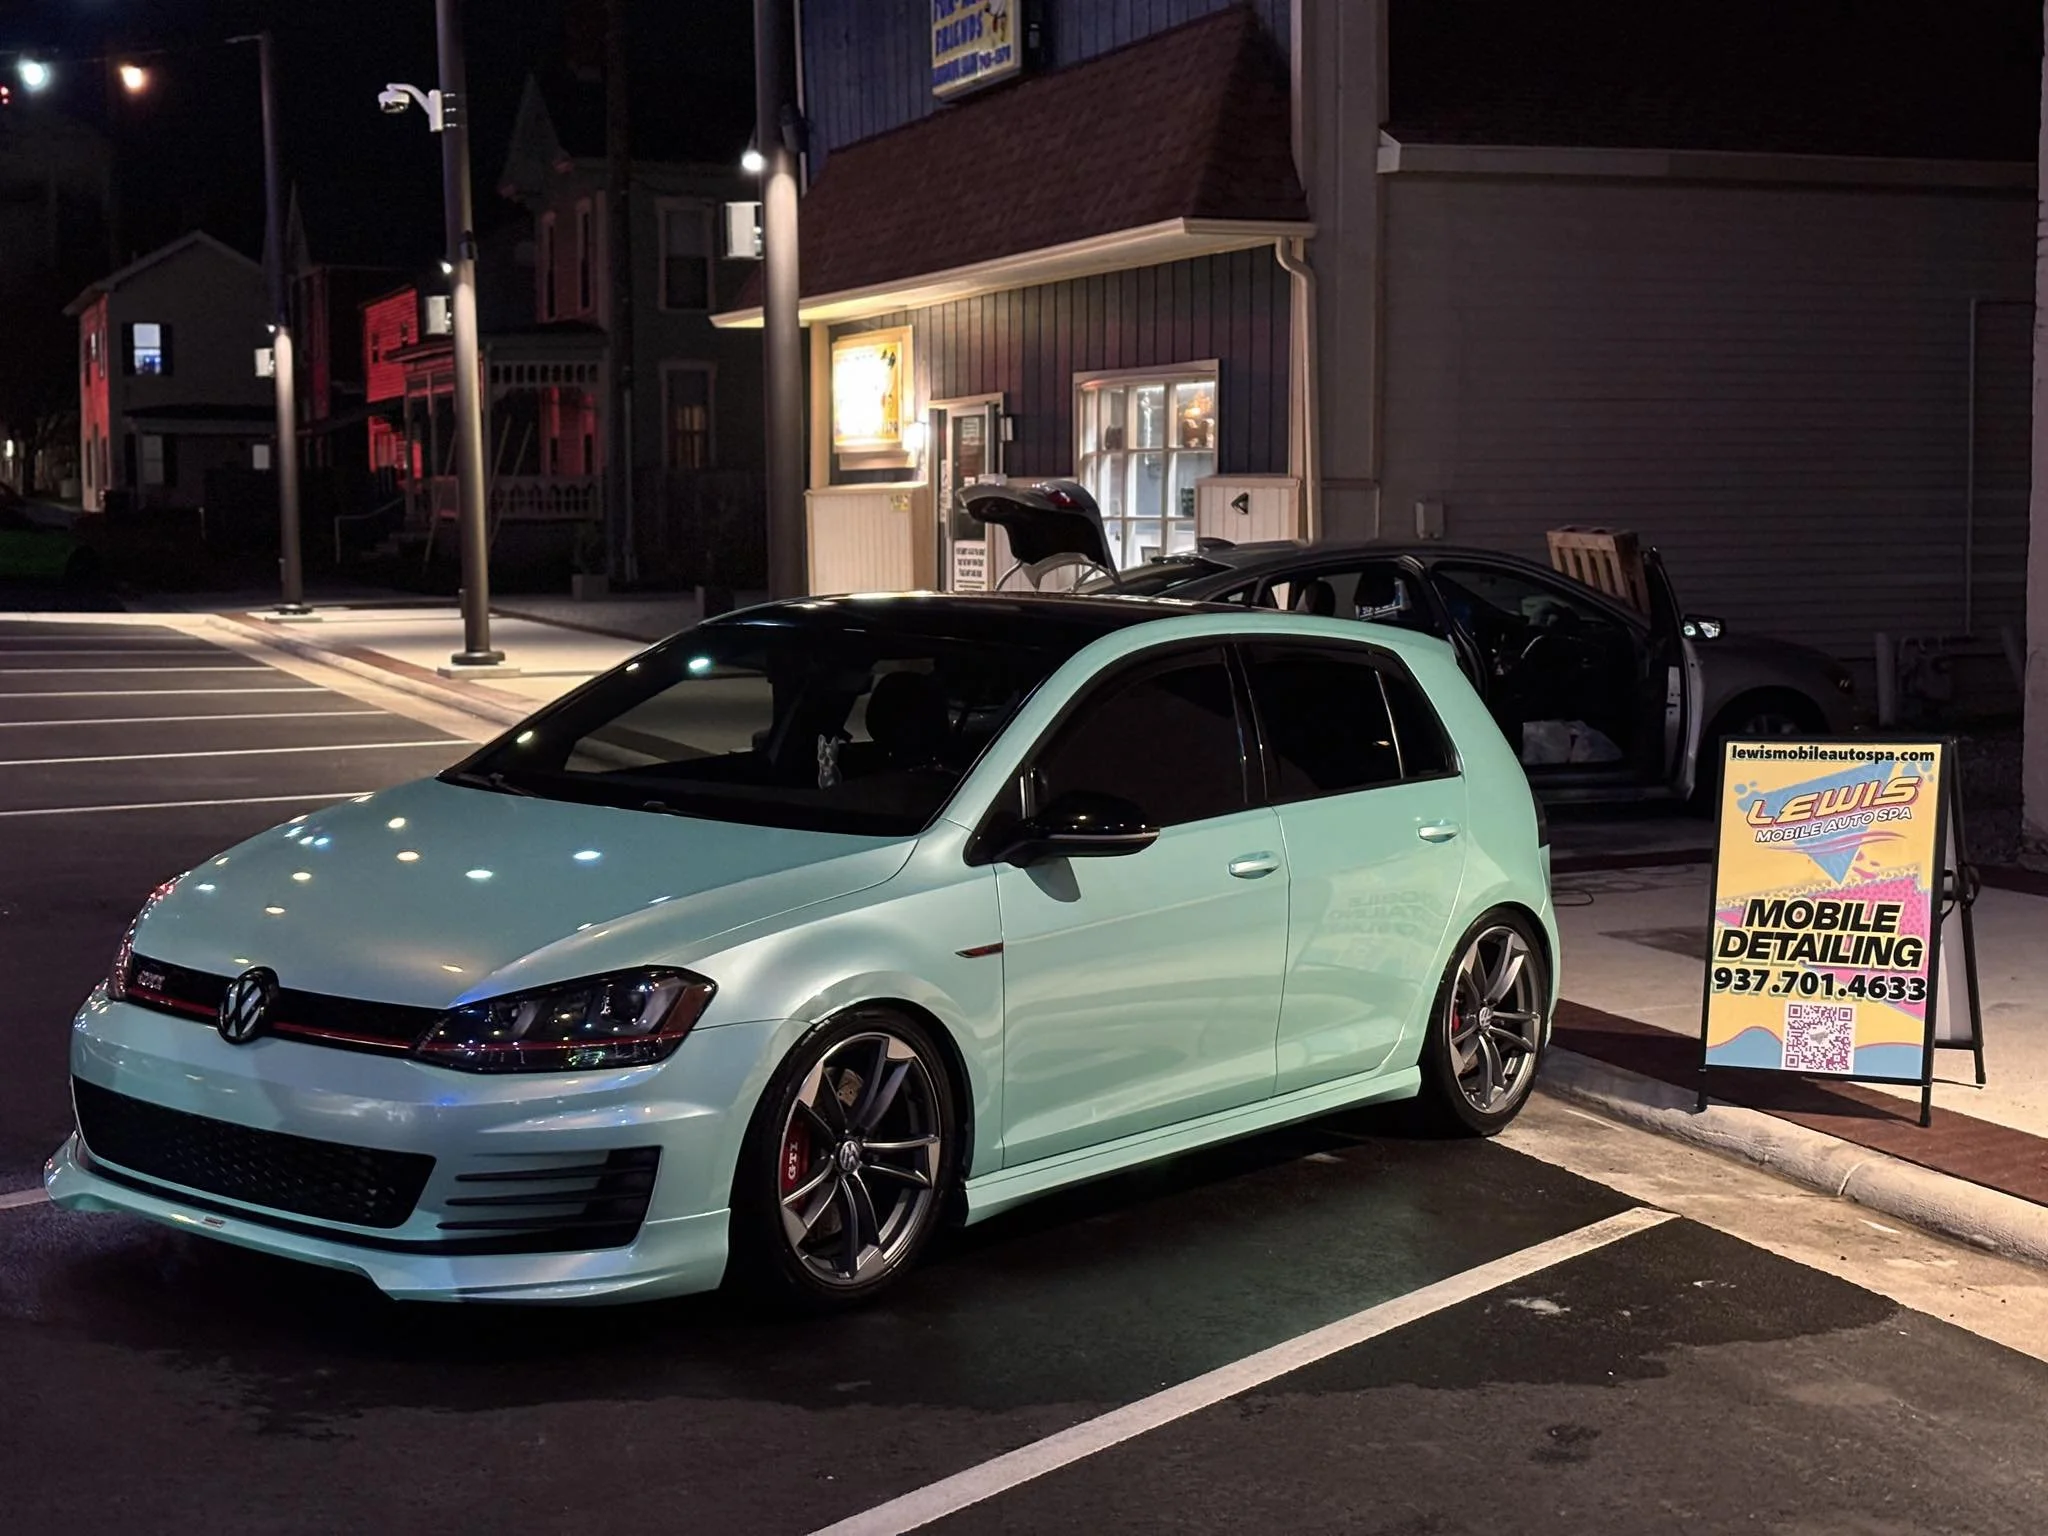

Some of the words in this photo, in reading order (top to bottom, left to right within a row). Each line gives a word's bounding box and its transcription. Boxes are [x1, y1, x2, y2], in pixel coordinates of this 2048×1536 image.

[1732, 745, 1935, 764] lewismobileautospa.com
[1747, 776, 1921, 826] LEWIS
[1755, 821, 1821, 843] MOBILE
[1824, 811, 1875, 833] AUTO
[1876, 807, 1912, 821] SPA
[1745, 899, 1901, 933] MOBILE
[1718, 929, 1923, 968] DETAILING
[1714, 967, 1926, 1000] 937.701.4633
[788, 1142, 798, 1180] GTI
